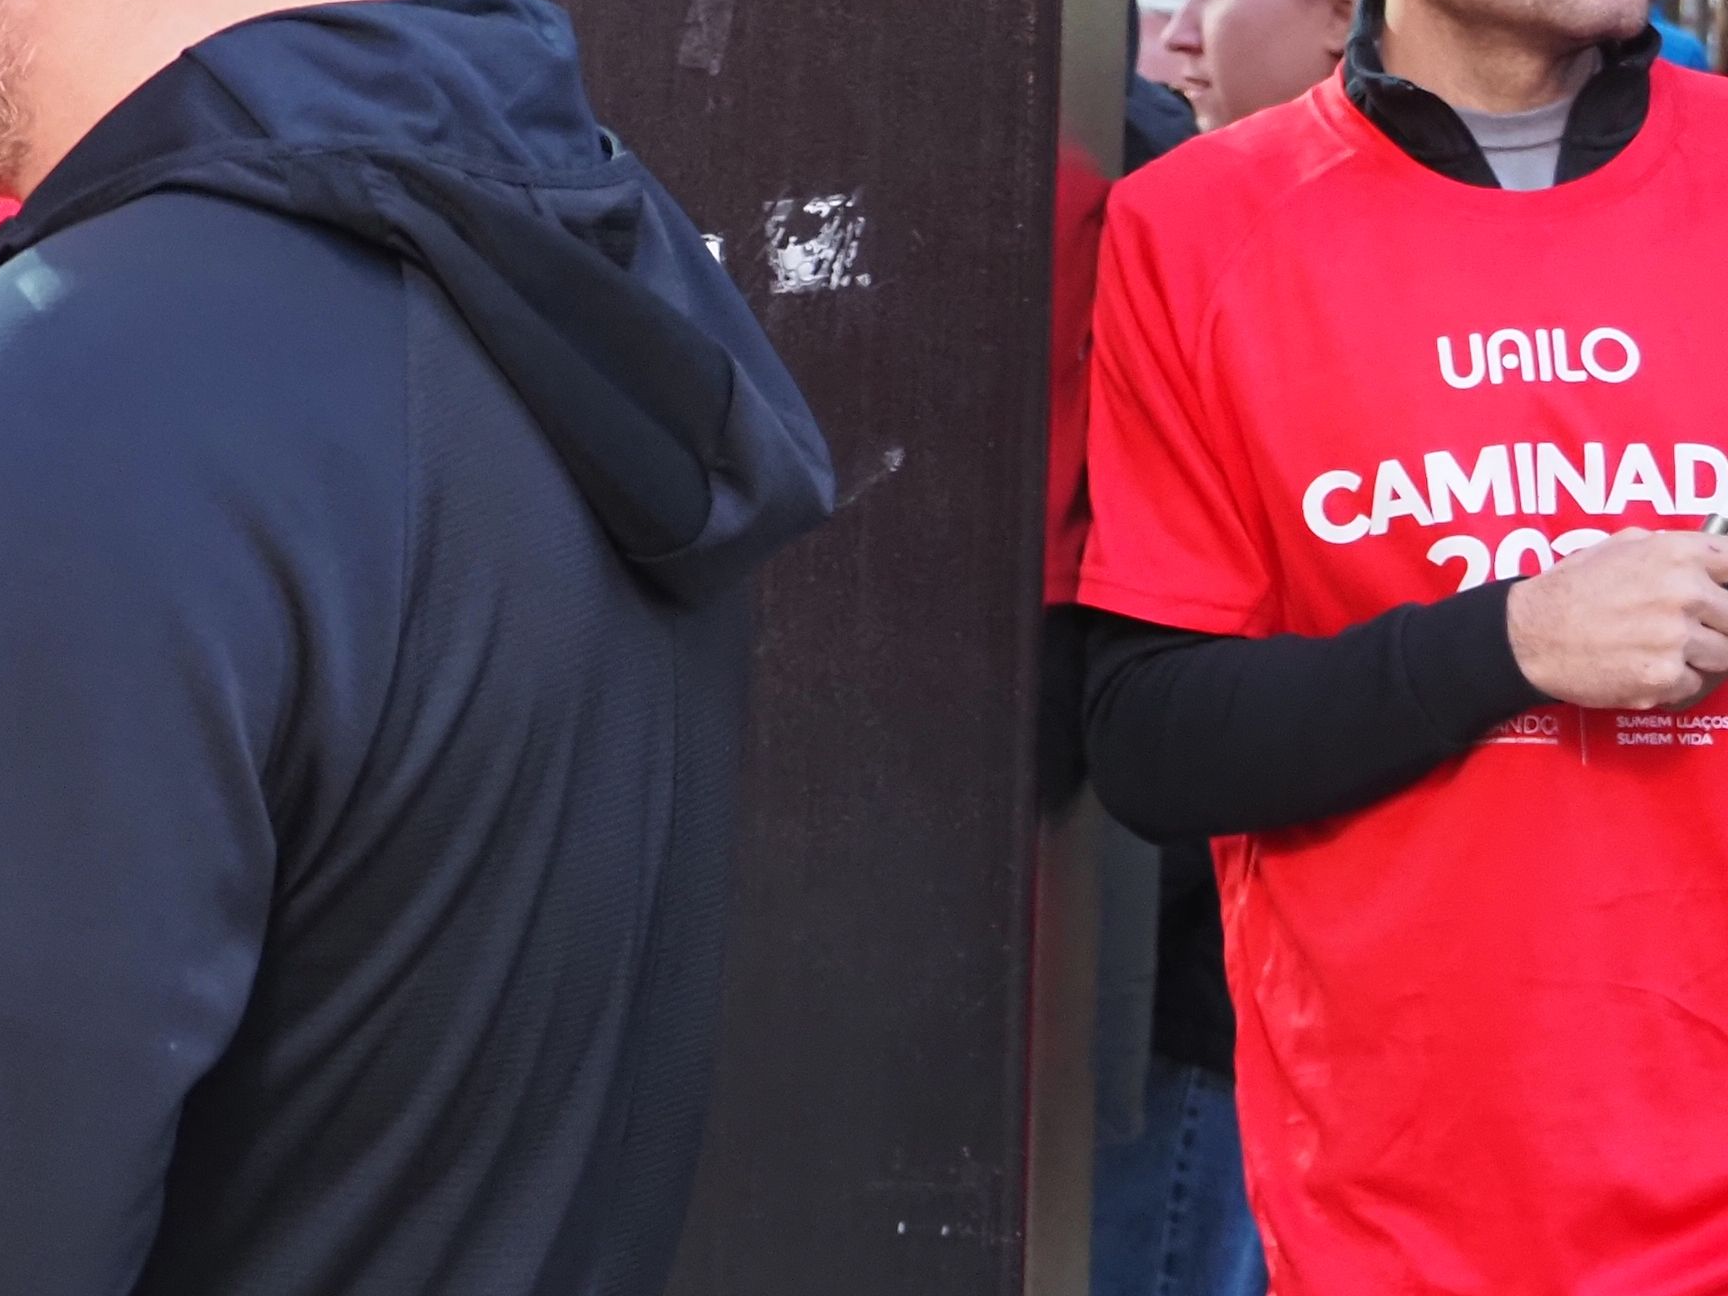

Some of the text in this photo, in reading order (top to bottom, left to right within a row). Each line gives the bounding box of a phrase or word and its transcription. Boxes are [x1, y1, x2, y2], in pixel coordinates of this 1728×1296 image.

[1437, 327, 1641, 389] UAILO
[1426, 527, 1611, 594] 20
[1616, 715, 1672, 728] SUMEM
[1616, 732, 1713, 745] SUMEM VIDA
